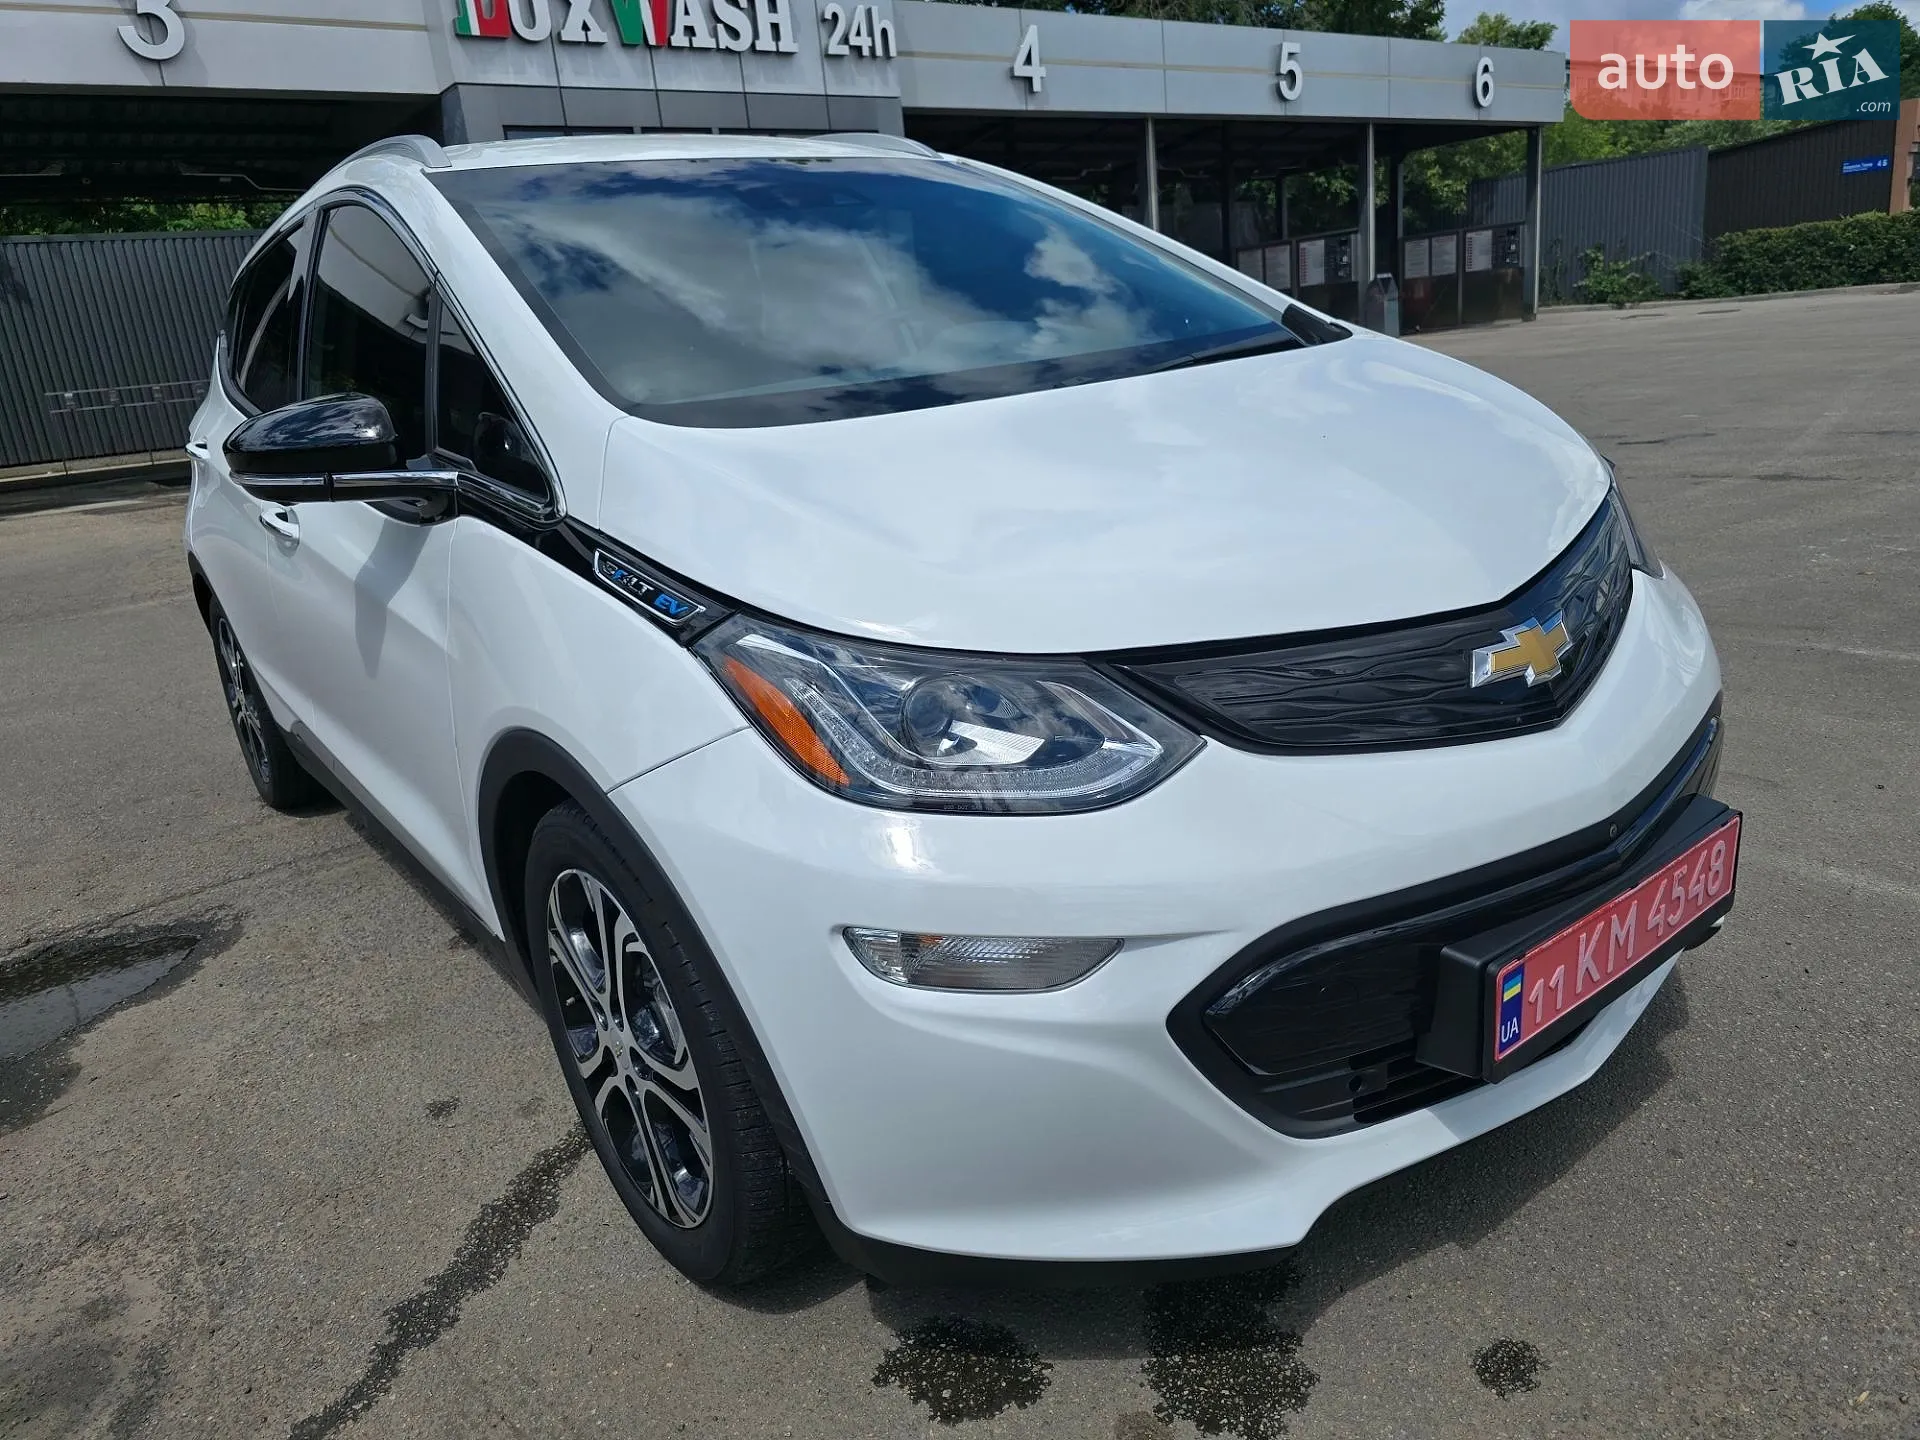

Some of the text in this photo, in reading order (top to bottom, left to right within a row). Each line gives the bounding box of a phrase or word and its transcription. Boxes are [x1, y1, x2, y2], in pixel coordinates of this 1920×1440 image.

[117, 0, 186, 60] 3
[823, 3, 898, 58] 24h
[1012, 24, 1047, 93] 4
[1279, 42, 1304, 102] 5
[1474, 56, 1495, 108] 6
[653, 593, 689, 616] EV
[1528, 839, 1726, 1025] 11 KM 4548
[1501, 1016, 1520, 1043] UA
